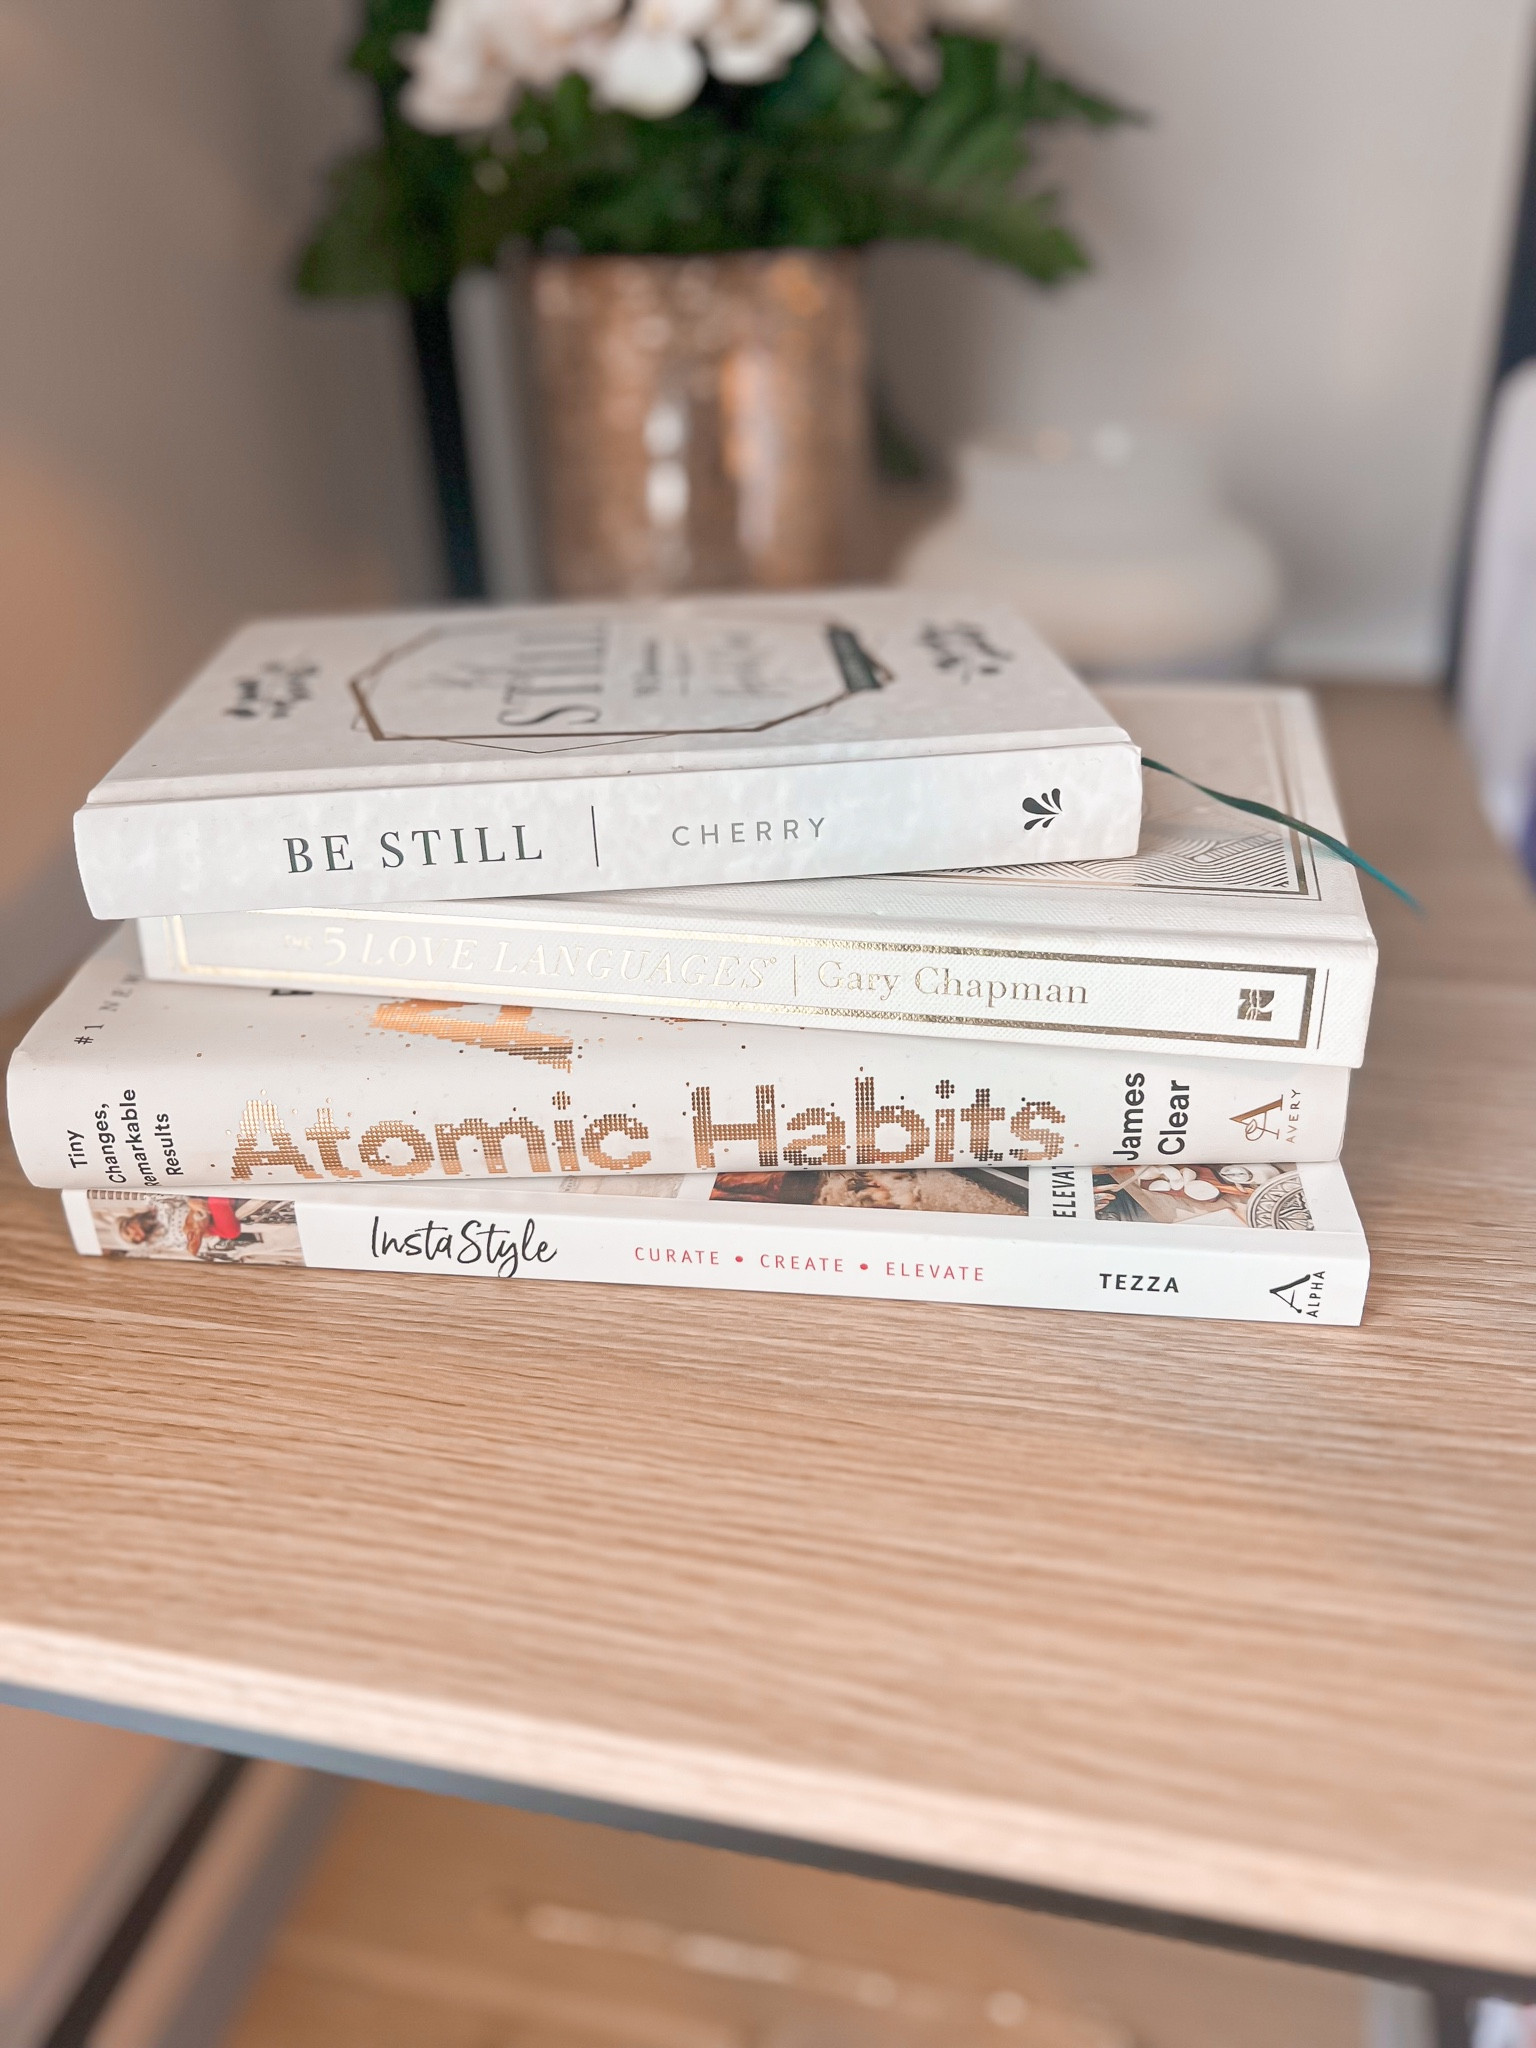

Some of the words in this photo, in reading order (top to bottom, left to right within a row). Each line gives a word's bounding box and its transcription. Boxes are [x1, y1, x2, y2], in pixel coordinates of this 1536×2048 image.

[283, 836, 355, 875] BE
[380, 824, 543, 869] STILL
[672, 816, 828, 848] CHERRY
[323, 926, 348, 967] 5
[361, 933, 479, 971] LOVE
[817, 961, 901, 1001] Gary
[914, 966, 1089, 1008] Chapman
[66, 1129, 88, 1169] Tiny
[94, 1103, 127, 1184] Changes,
[119, 1089, 162, 1187] Remarkable
[154, 1113, 184, 1175] Results
[230, 1090, 653, 1180] Atomic
[690, 1076, 1066, 1169] Habits
[1113, 1072, 1146, 1161] James
[1157, 1079, 1190, 1156] Clear
[1285, 1089, 1301, 1144] AVERY
[371, 1215, 558, 1279] InstaStyle
[634, 1246, 721, 1266] CURATE
[760, 1253, 844, 1273] CREATE
[885, 1261, 985, 1282] ELEVATE
[1099, 1273, 1180, 1293] TEZZA
[1306, 1270, 1326, 1318] ALPHA
